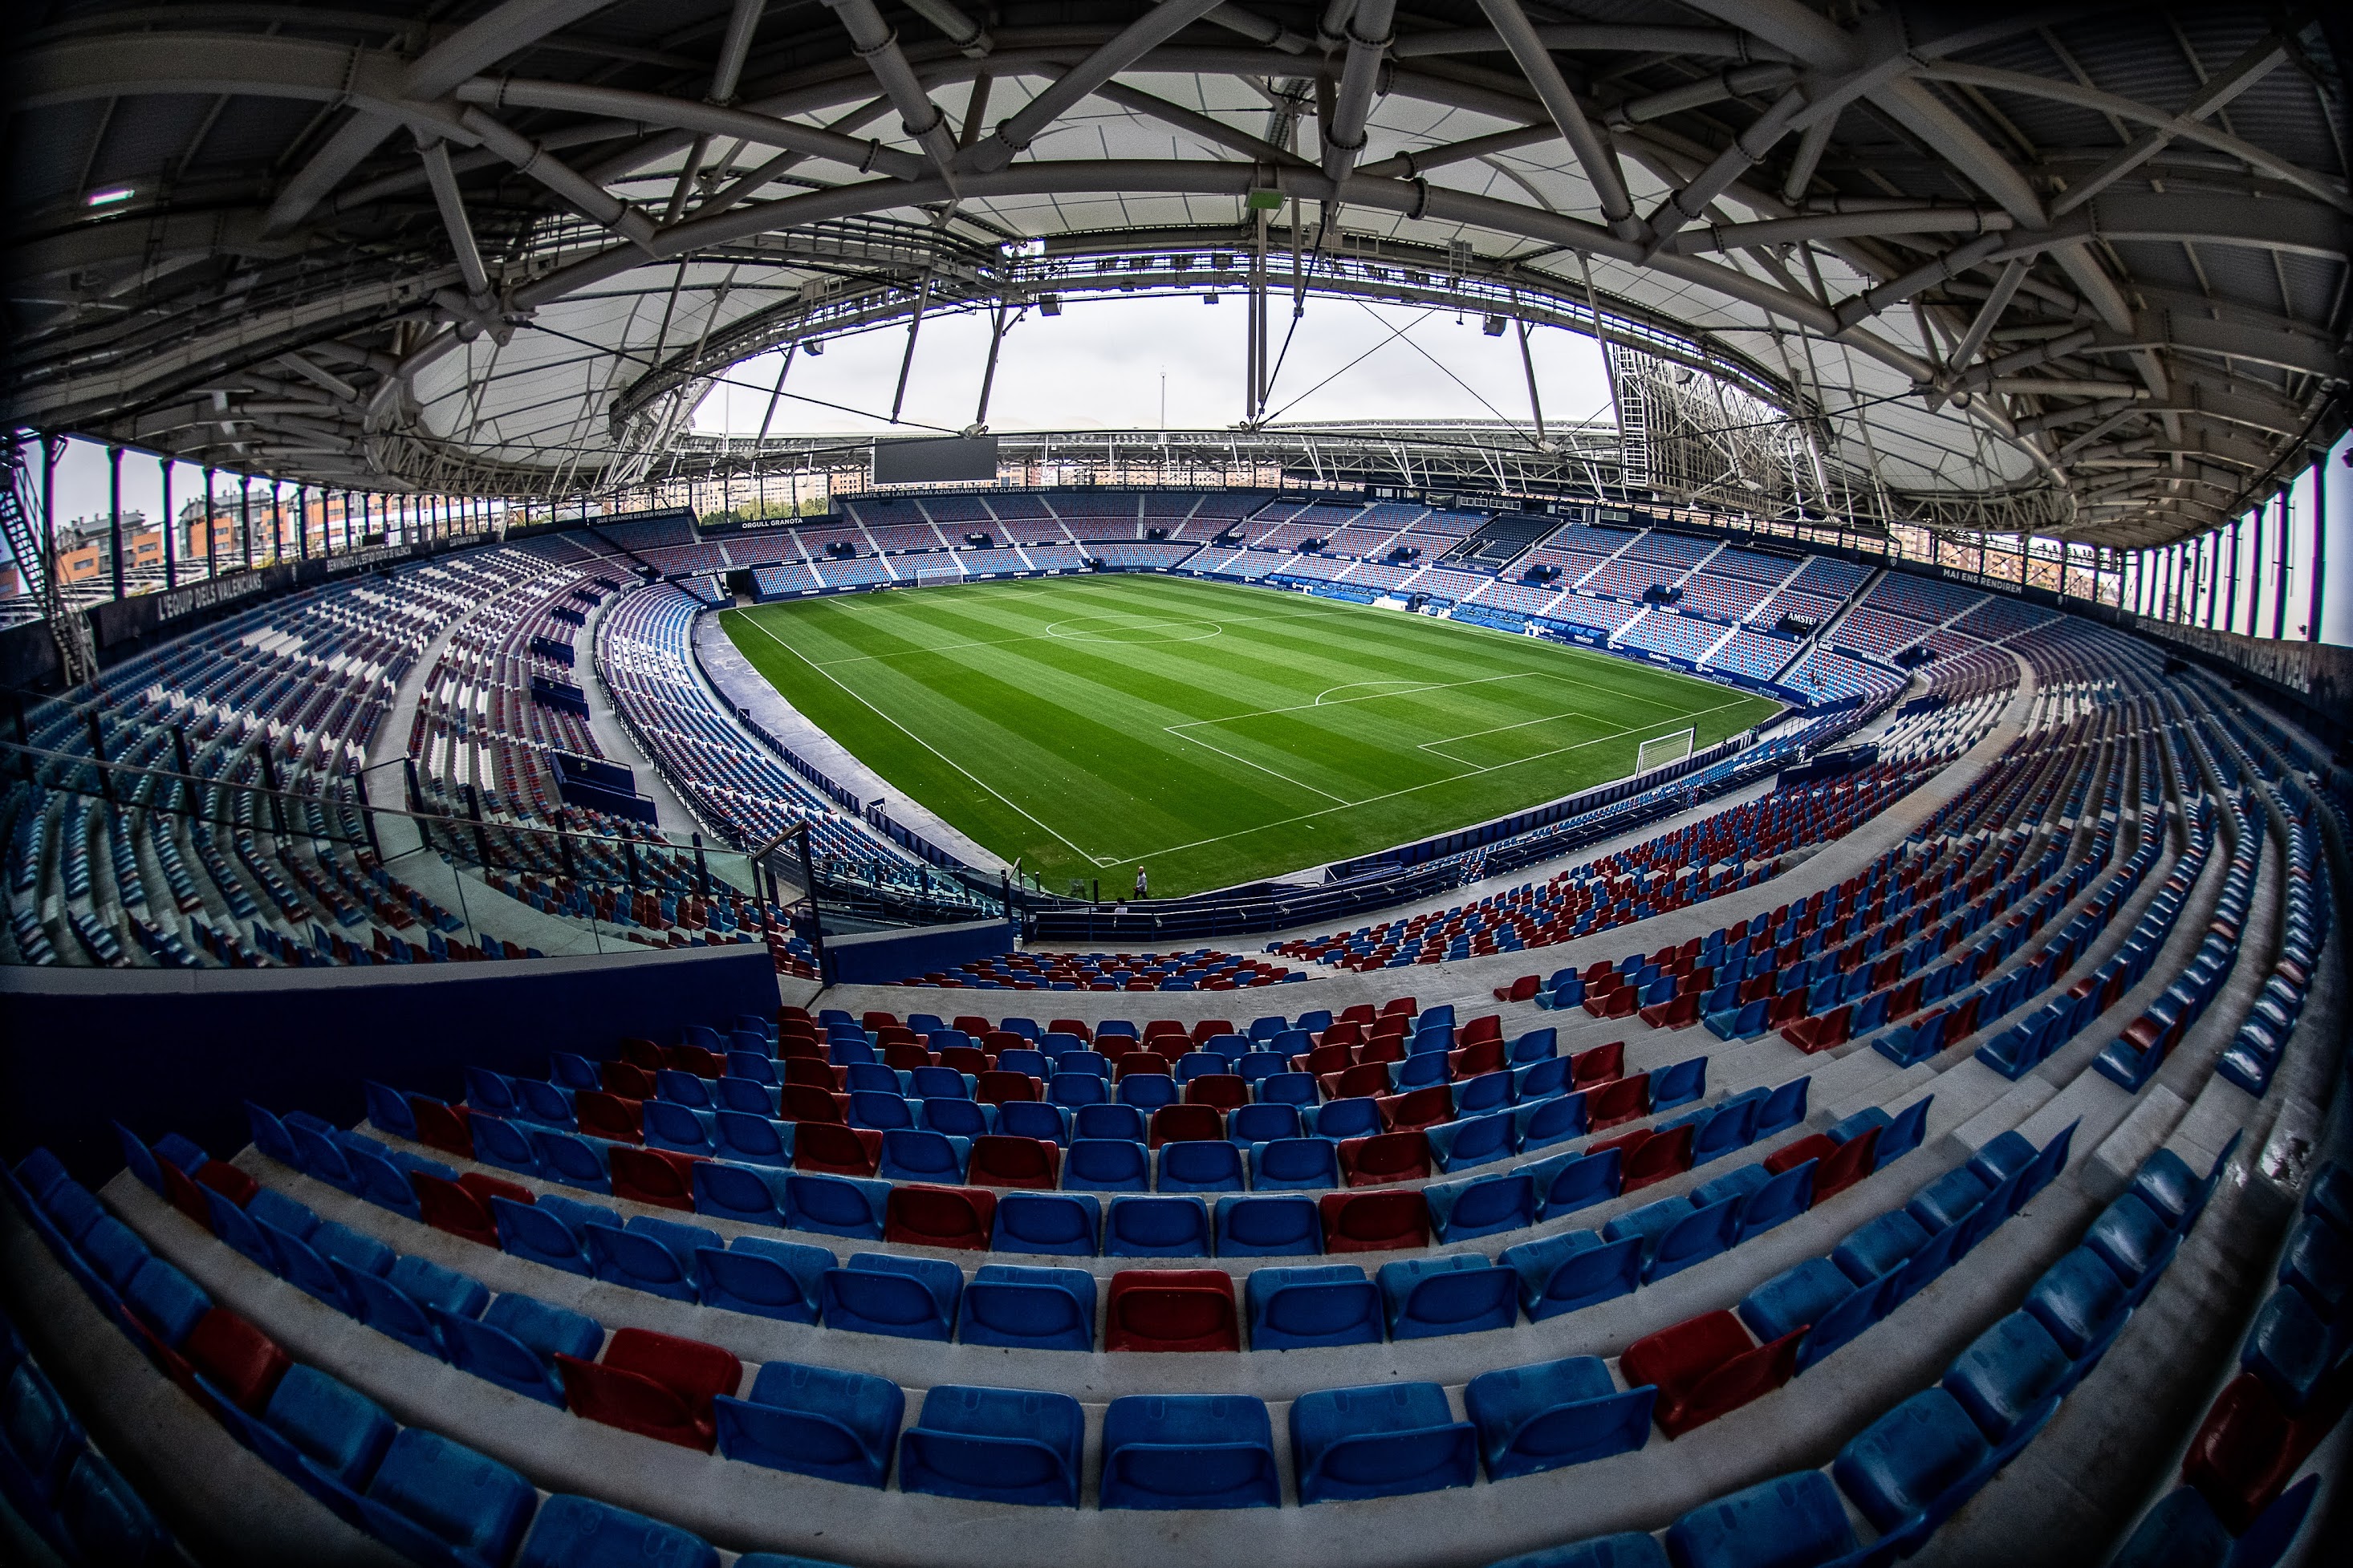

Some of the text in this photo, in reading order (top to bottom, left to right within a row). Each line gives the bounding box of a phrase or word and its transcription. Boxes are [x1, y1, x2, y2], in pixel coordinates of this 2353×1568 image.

[609, 514, 632, 522] GRANDE
[742, 518, 803, 529] ORGULL GRANOTA
[717, 564, 750, 573] RAMINATRANS
[1943, 568, 2022, 594] MAI ENS RENDIREM
[158, 573, 262, 621] L'EQUIP DELS VALENCIANS
